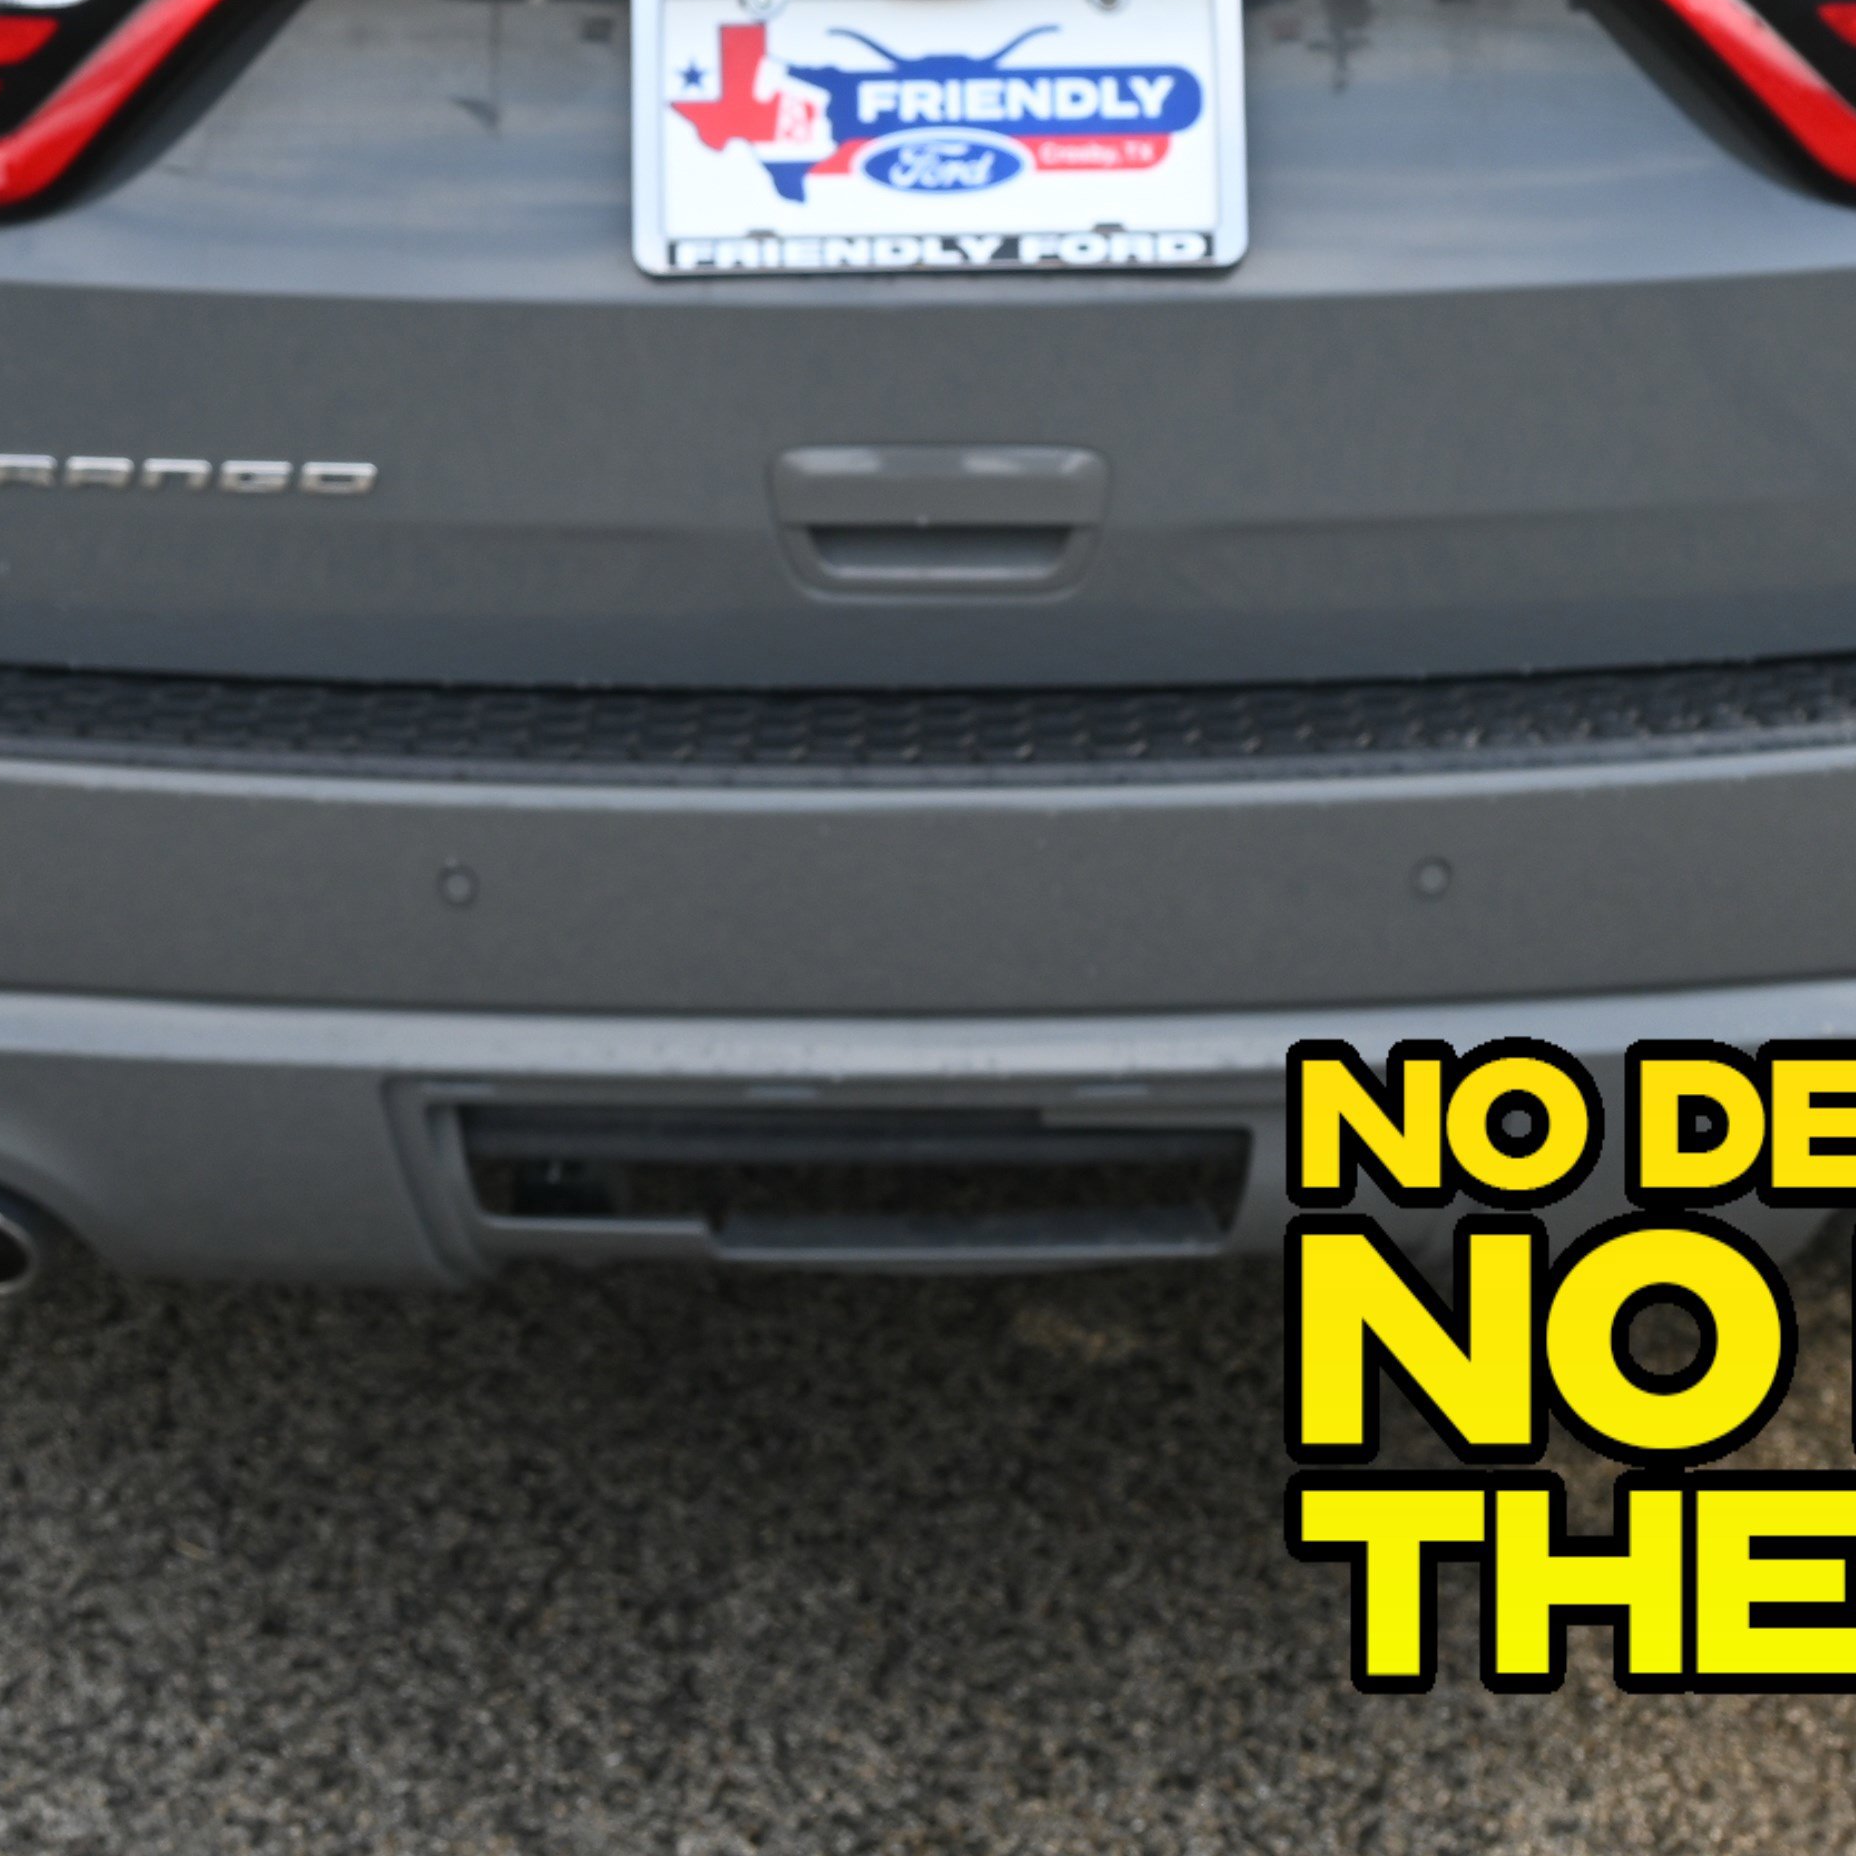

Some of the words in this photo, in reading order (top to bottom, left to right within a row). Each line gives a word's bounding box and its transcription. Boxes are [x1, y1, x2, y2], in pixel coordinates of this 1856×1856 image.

[855, 76, 1177, 124] FRIENDLY
[888, 142, 996, 189] Ford
[676, 233, 1007, 269] FRIENDLY
[1018, 230, 1208, 265] FORD
